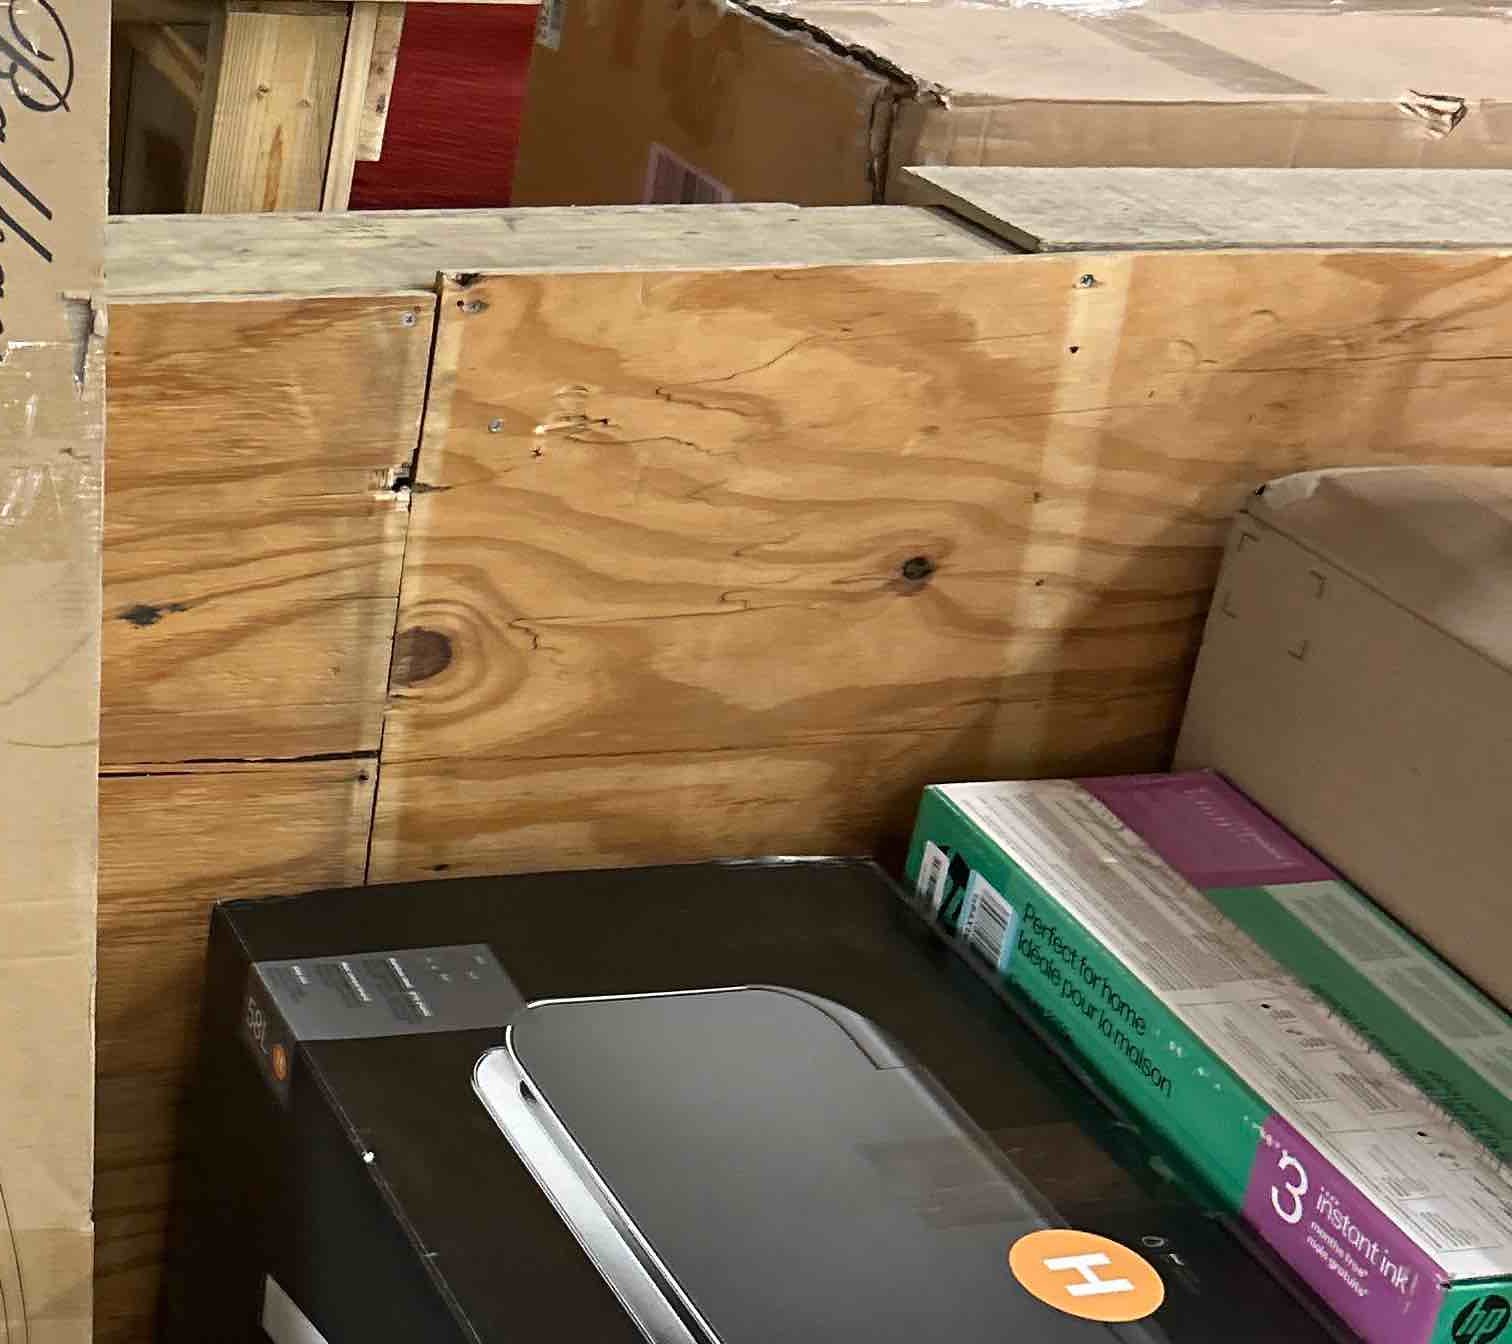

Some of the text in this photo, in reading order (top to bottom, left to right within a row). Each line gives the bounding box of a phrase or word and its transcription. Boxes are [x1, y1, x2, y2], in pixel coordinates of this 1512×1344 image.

[1023, 902, 1146, 1036] Perfect for home
[1062, 979, 1098, 1020] pour
[1097, 1009, 1112, 1038] la
[1113, 1030, 1172, 1097] maison
[1042, 1252, 1135, 1297] H
[1271, 1152, 1409, 1295] 3 instant ink
